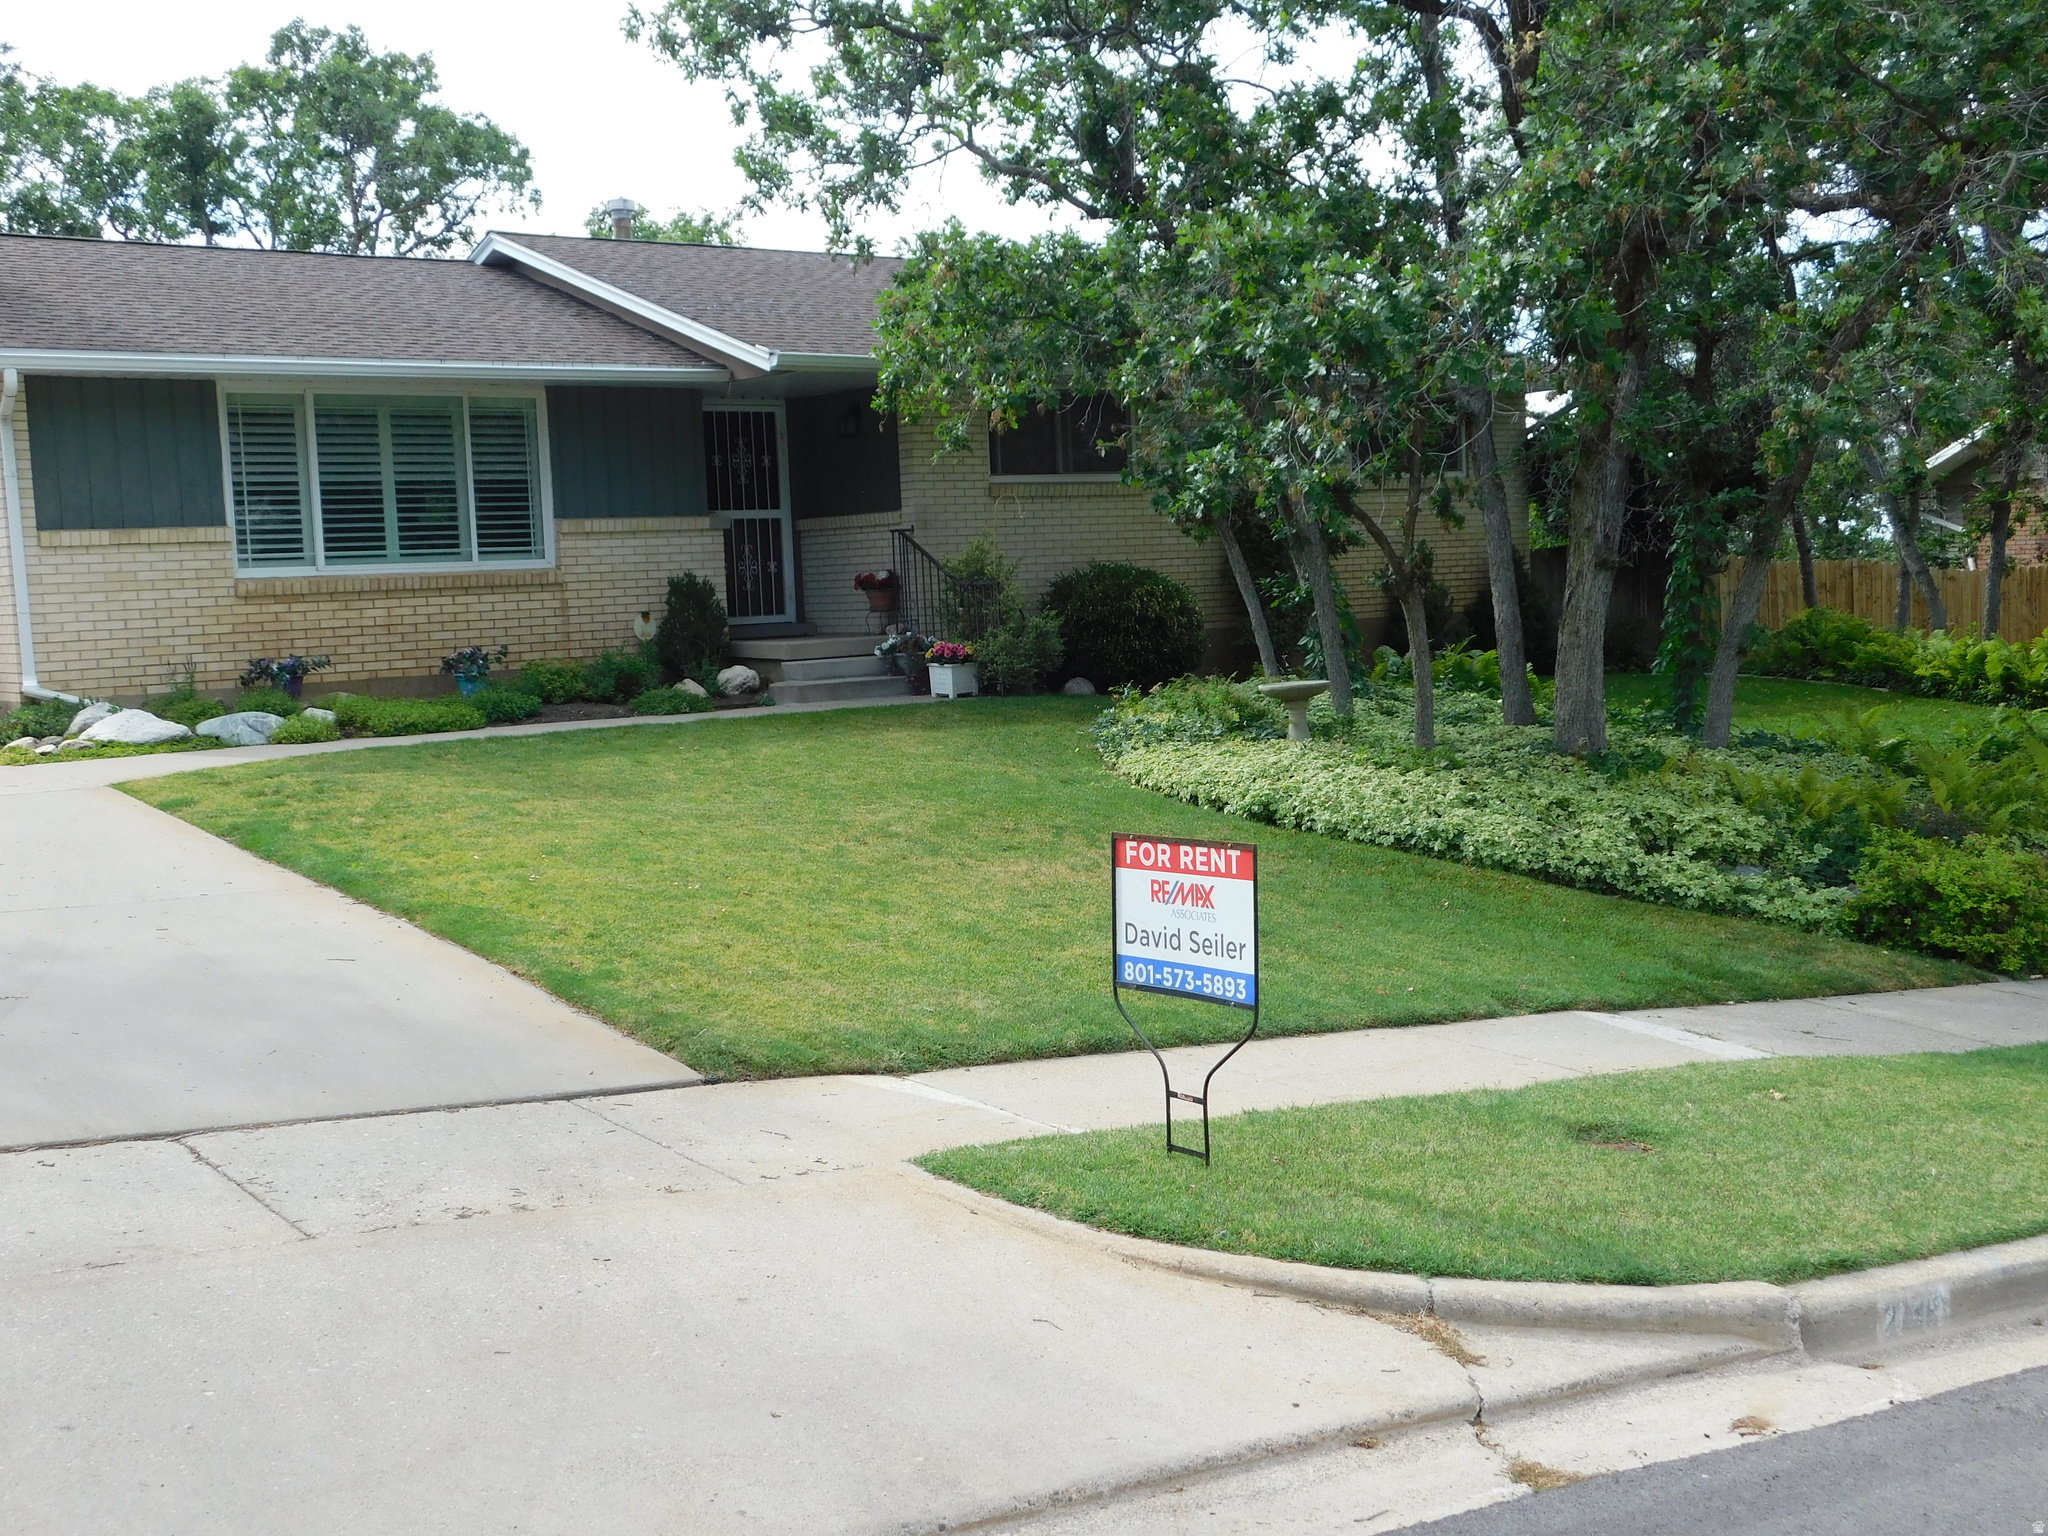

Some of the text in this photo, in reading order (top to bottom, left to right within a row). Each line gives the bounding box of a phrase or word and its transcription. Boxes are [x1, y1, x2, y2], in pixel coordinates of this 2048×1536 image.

[1125, 840, 1241, 874] FOR RENT
[1171, 909, 1216, 923] ASSOCIATES
[1124, 922, 1246, 960] David Seiler
[1124, 961, 1247, 999] 801-573-5893
